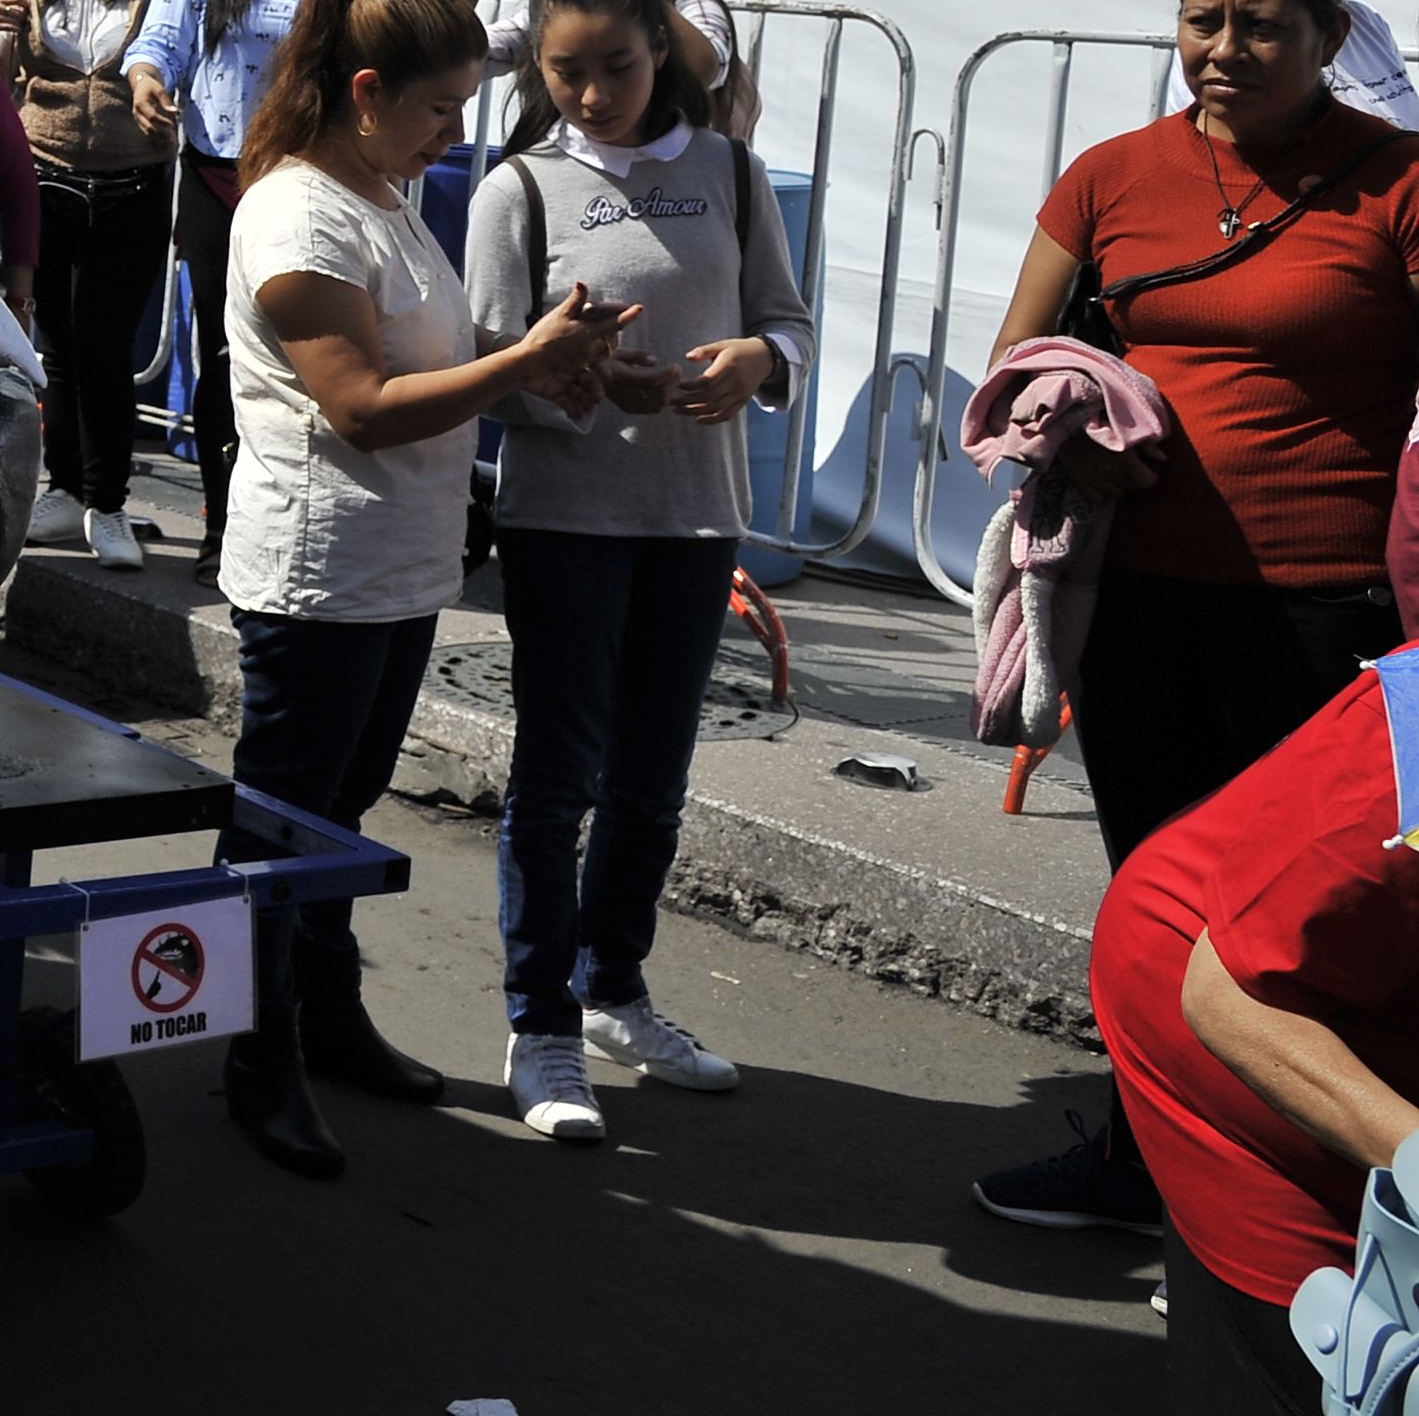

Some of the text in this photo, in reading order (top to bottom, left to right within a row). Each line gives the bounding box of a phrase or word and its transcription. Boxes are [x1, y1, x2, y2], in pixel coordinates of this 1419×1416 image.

[580, 187, 707, 230] Par Amour
[130, 1011, 207, 1044] NO TOCAR
